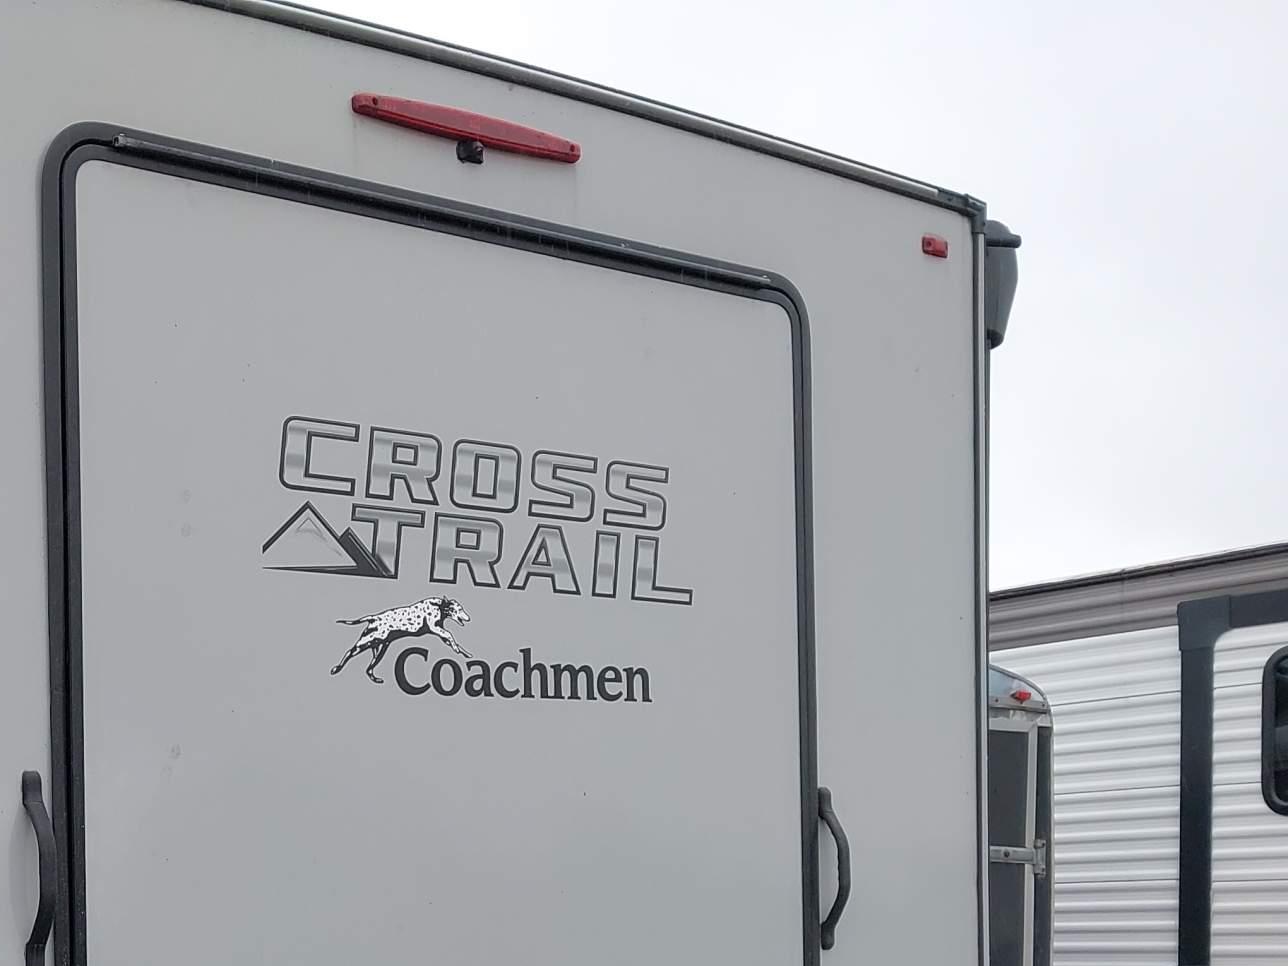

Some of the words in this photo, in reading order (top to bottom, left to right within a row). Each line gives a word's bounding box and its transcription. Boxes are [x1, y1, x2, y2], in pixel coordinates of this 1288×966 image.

[278, 415, 670, 532] CROSS
[350, 502, 694, 606] TRAIL
[393, 647, 653, 703] Coachmen
